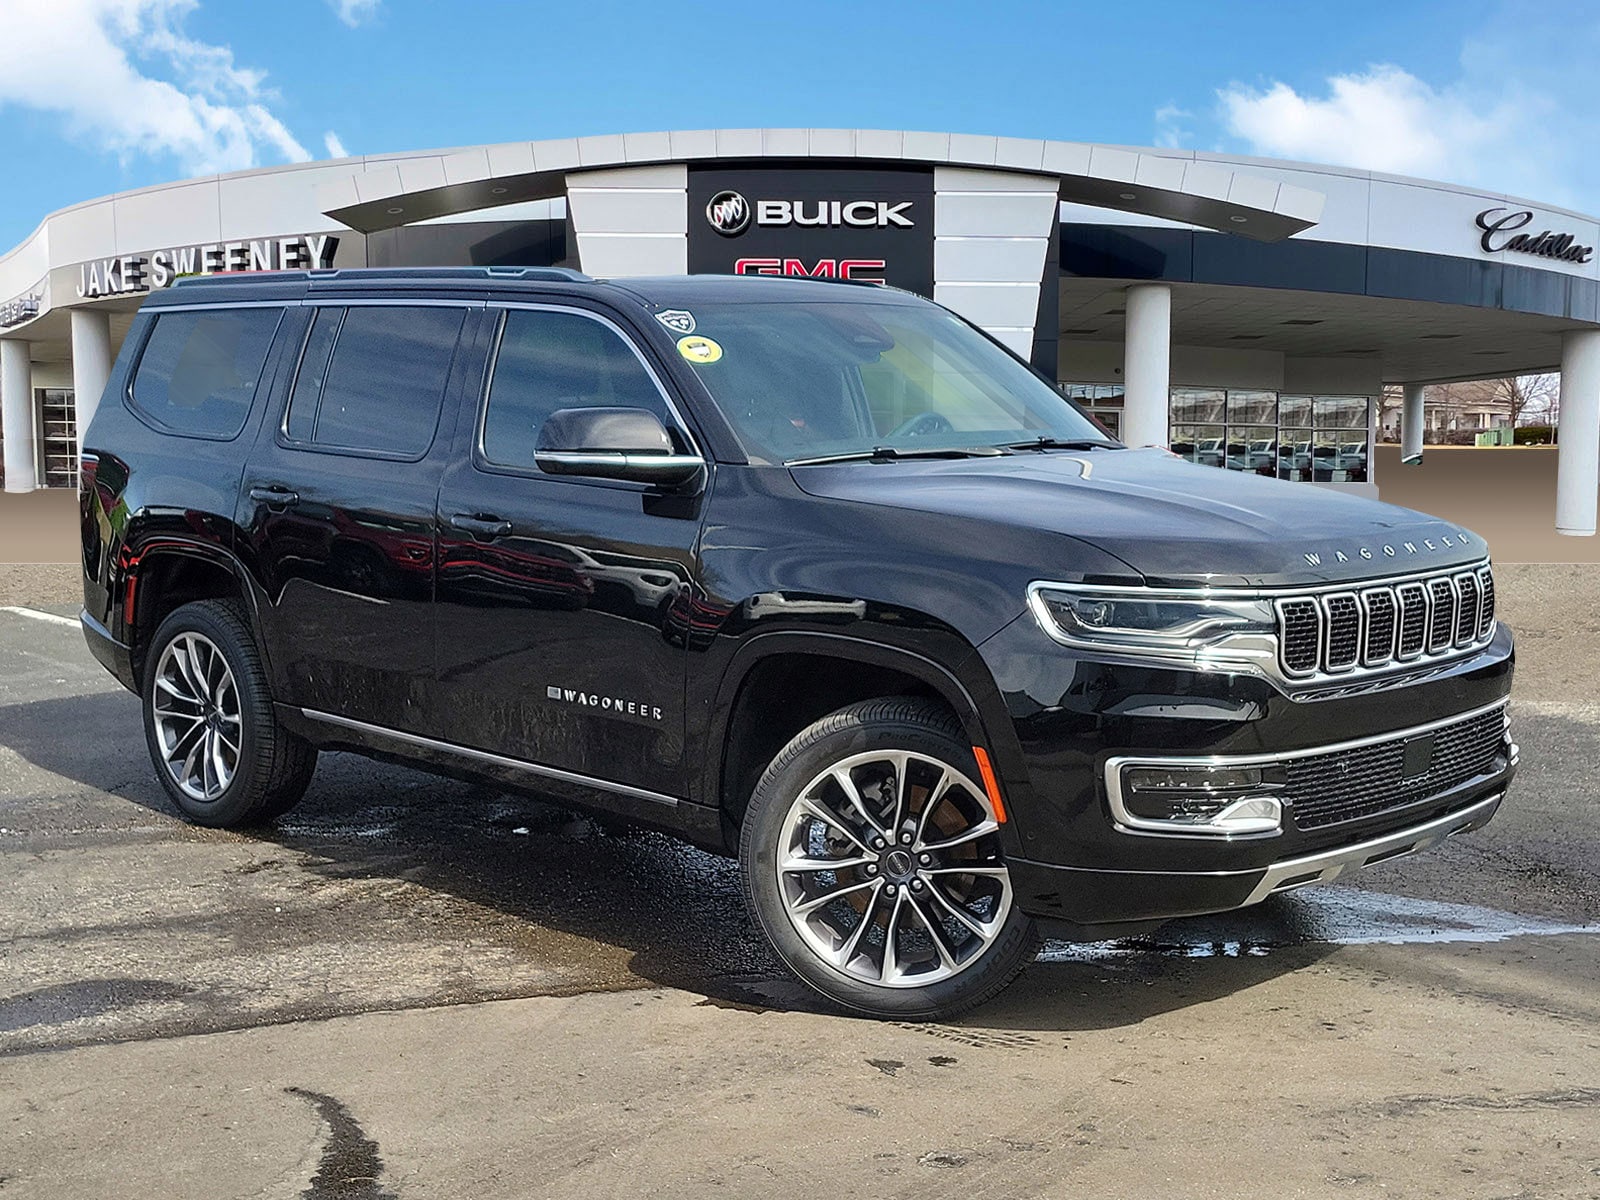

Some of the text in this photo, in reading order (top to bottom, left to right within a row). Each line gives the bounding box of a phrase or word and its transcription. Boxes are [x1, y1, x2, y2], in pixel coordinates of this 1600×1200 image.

[757, 200, 915, 226] BUICK
[1475, 207, 1593, 263] Cadillac
[76, 235, 335, 297] JAKE SWEENEY
[735, 258, 885, 285] GMC
[1304, 533, 1470, 567] WAGONEER
[564, 689, 662, 720] WAGONEER
